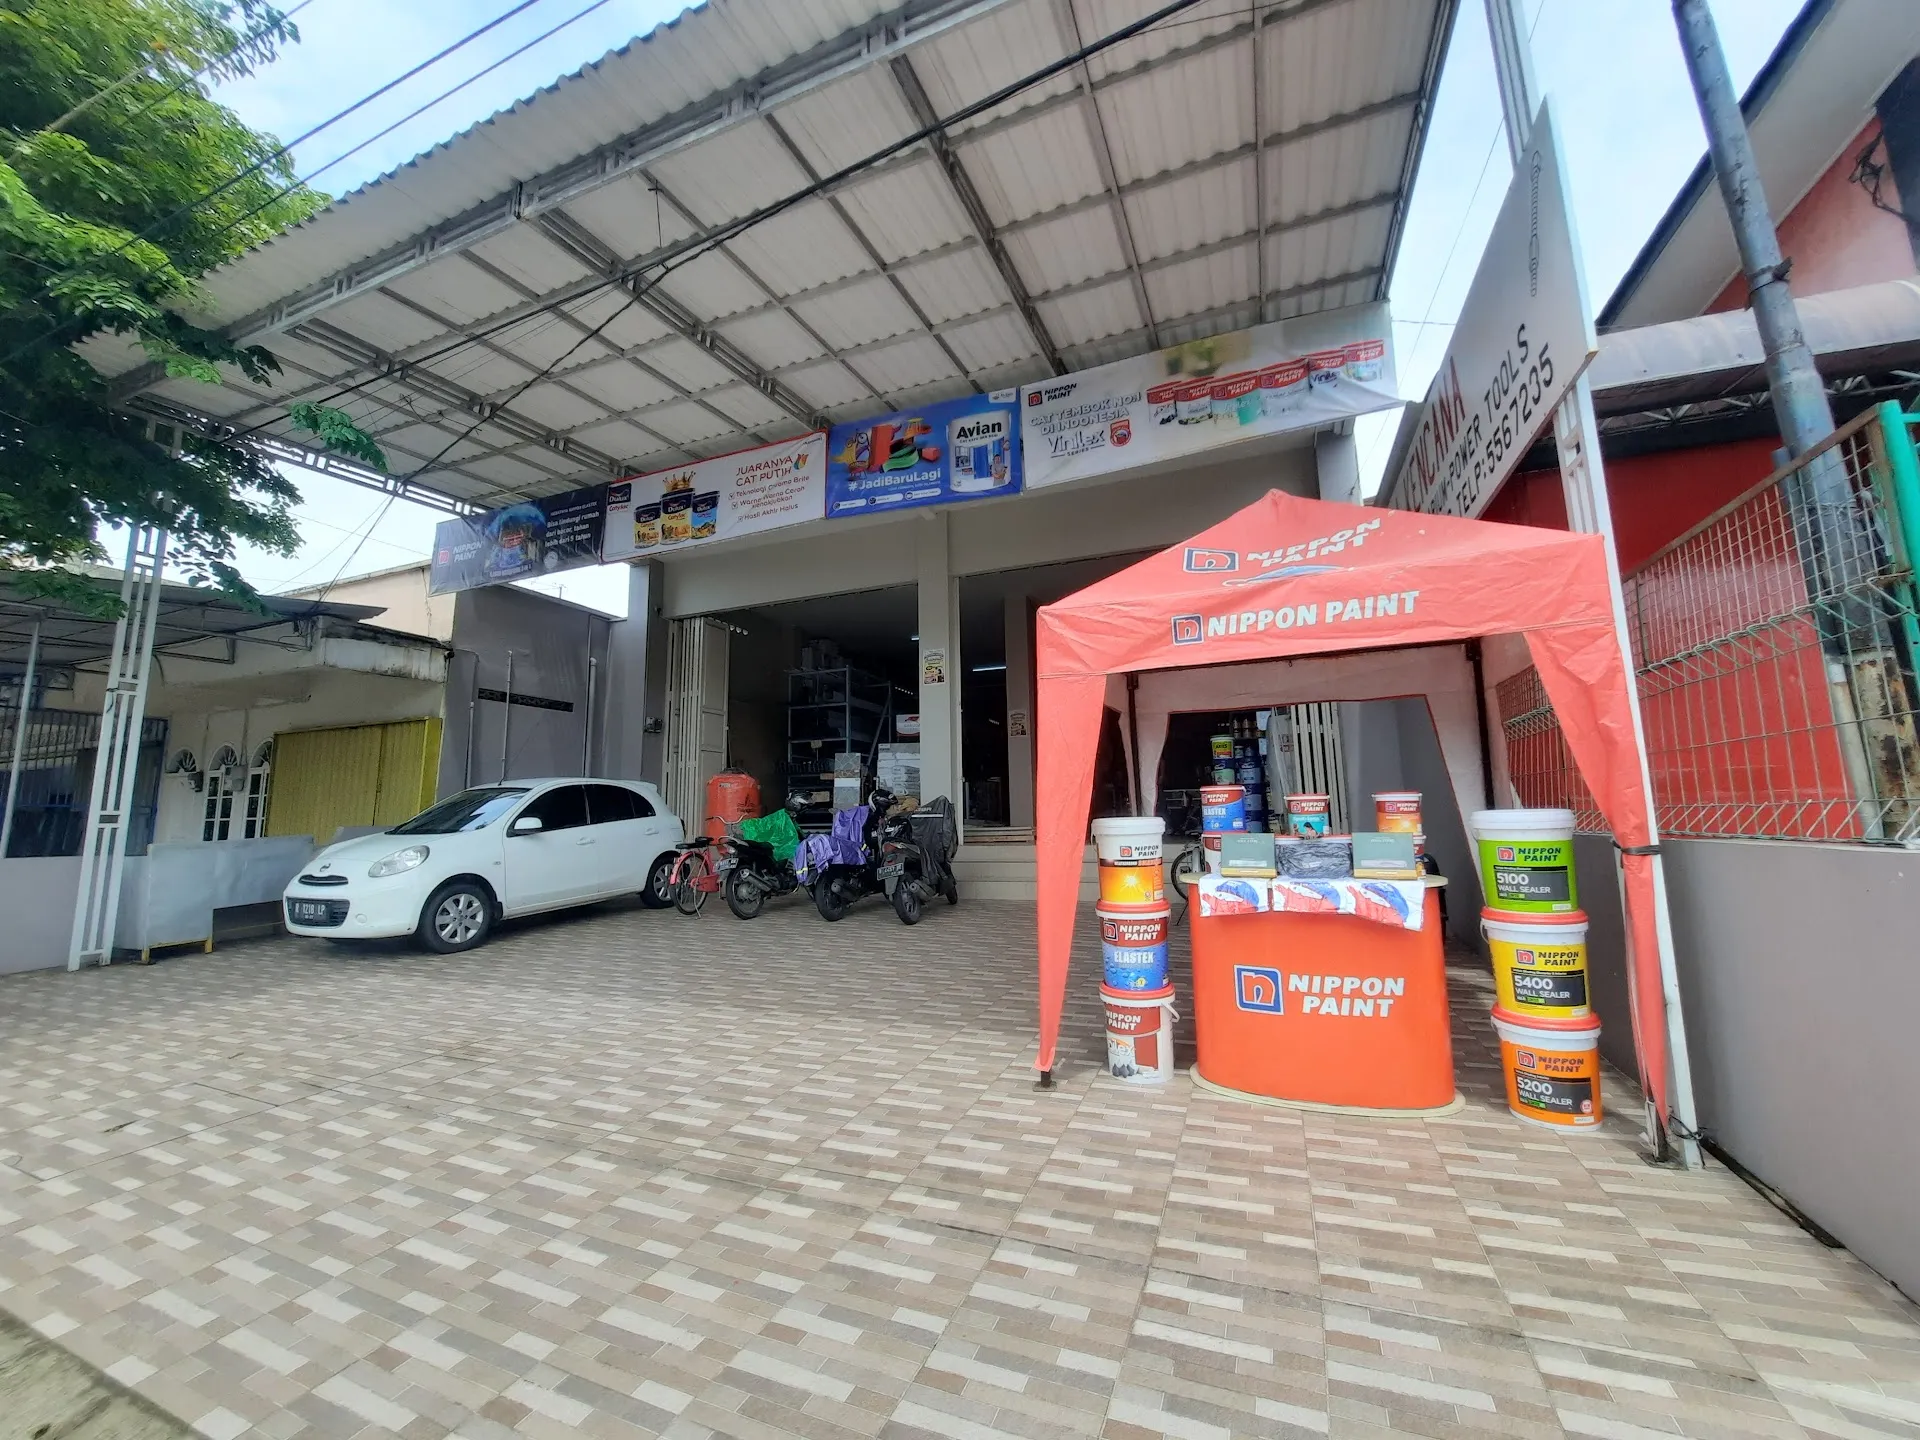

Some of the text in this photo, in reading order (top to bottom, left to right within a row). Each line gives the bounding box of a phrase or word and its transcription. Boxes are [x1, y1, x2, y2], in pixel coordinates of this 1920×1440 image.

[1484, 323, 1531, 424] TOOLS
[1044, 383, 1077, 396] NIPPON
[1227, 379, 1256, 391] NIPPON
[1231, 384, 1253, 395] PAINT
[1047, 390, 1072, 401] PAINT
[1030, 412, 1053, 426] CAT
[1056, 399, 1110, 420] TEMBOK
[1041, 407, 1130, 435] DI INDONESIA
[956, 421, 1002, 439] Avian
[736, 455, 793, 476] JUARANYA
[736, 467, 792, 487] CAT PUTIH
[736, 486, 767, 498] Teknologi
[793, 475, 810, 483] Brite
[780, 503, 798, 512] Halus
[1246, 518, 1381, 561] NIPPON
[452, 541, 483, 554] NIPPON
[1261, 533, 1369, 568] PAINT
[454, 550, 477, 562] PAINT
[1207, 603, 1318, 638] NIPPON
[1325, 591, 1420, 624] PAINT
[1518, 847, 1562, 855] NIPPON
[1496, 872, 1530, 885] 5100
[1498, 884, 1551, 894] WALL SEALER
[317, 904, 326, 915] LP
[1119, 924, 1161, 933] NIPPON
[1124, 932, 1158, 940] PAINT
[1113, 951, 1154, 964] ELASTEX
[1538, 951, 1579, 959] NIPPON
[1288, 974, 1405, 997] NIPPON
[1514, 975, 1554, 990] 5400
[1515, 987, 1570, 999] WALL SEALER
[1301, 995, 1394, 1018] PAINT
[1106, 1010, 1141, 1023] NIPPON
[1108, 1019, 1137, 1030] PAINT
[1538, 1056, 1584, 1065] NIPPON
[1545, 1064, 1581, 1073] PAINT
[1516, 1076, 1553, 1095] 5200
[1518, 1089, 1539, 1101] WALL
[1540, 1095, 1573, 1106] SEALER
